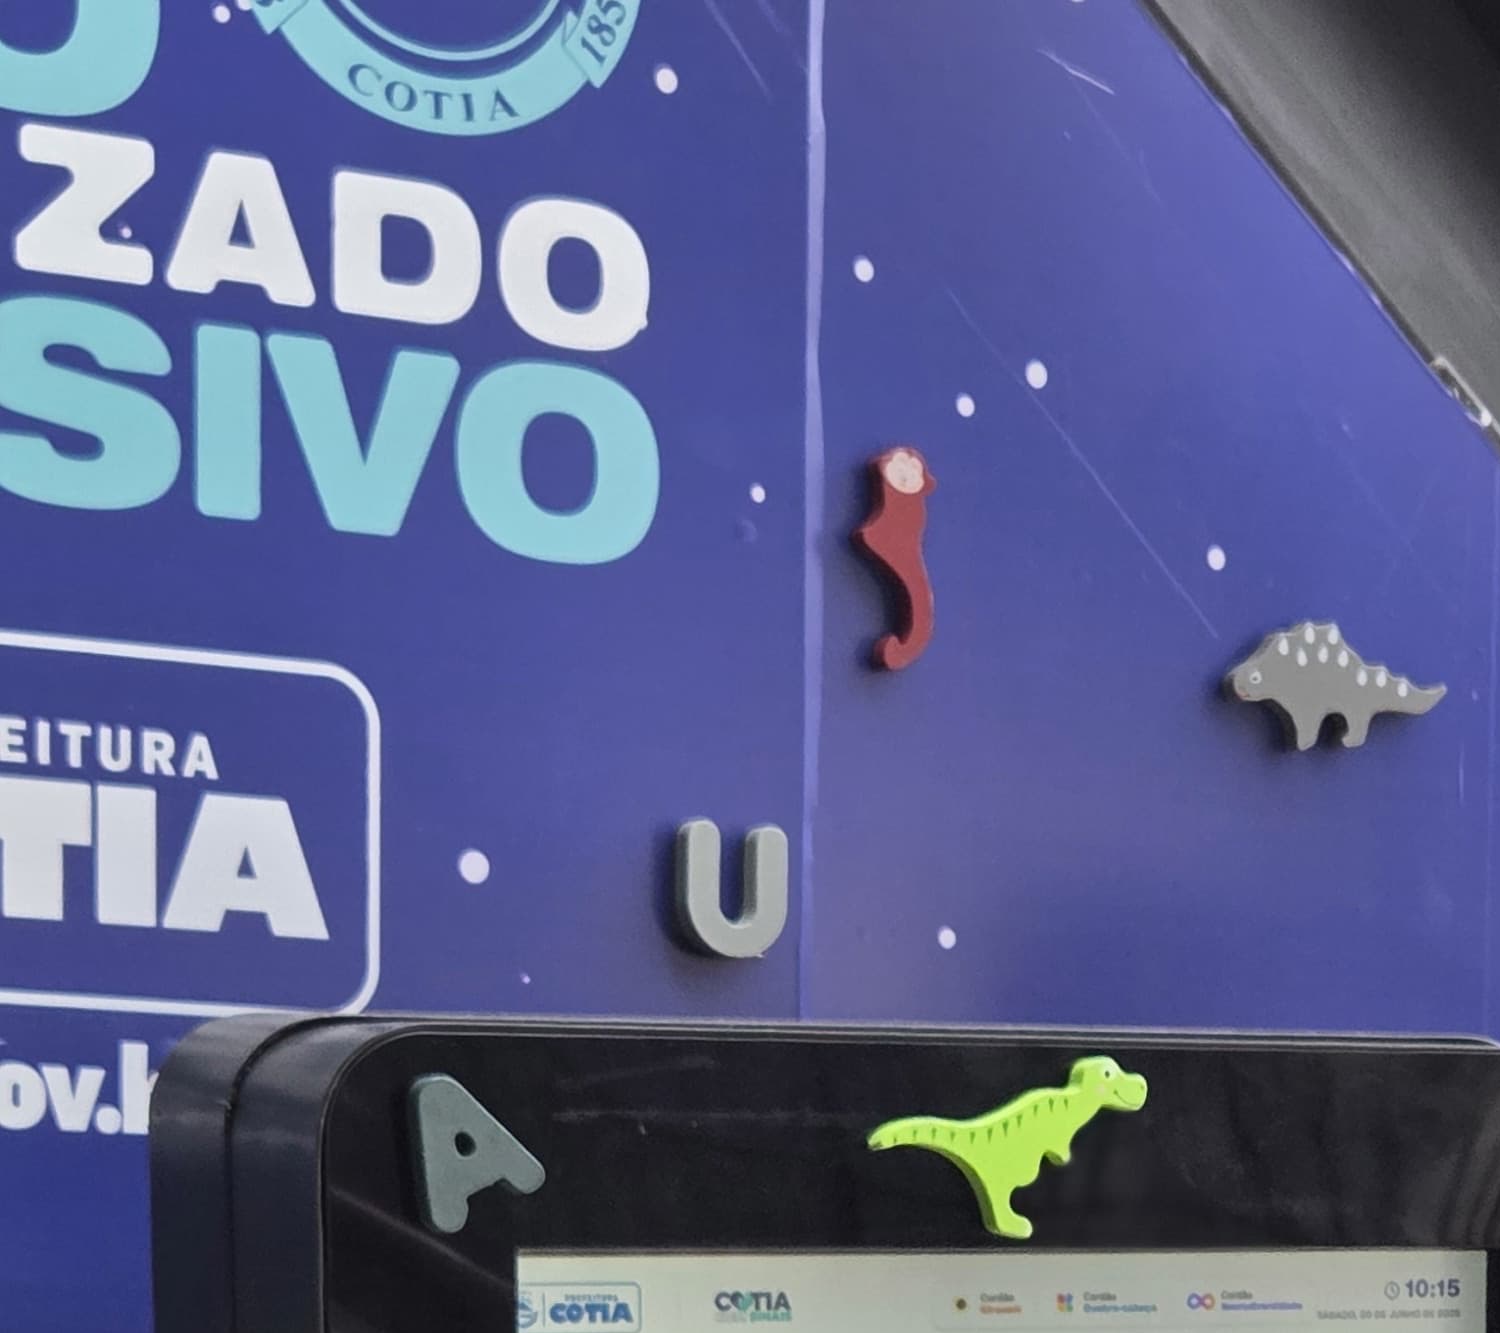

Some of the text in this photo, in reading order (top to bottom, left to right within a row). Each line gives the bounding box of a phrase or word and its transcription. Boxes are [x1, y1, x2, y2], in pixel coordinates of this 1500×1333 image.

[347, 63, 521, 122] COTIA
[14, 123, 650, 351] ZADO
[677, 817, 789, 958] U
[412, 1072, 545, 1233] A
[550, 1302, 634, 1323] COTIA
[1405, 1279, 1460, 1298] 10:15
